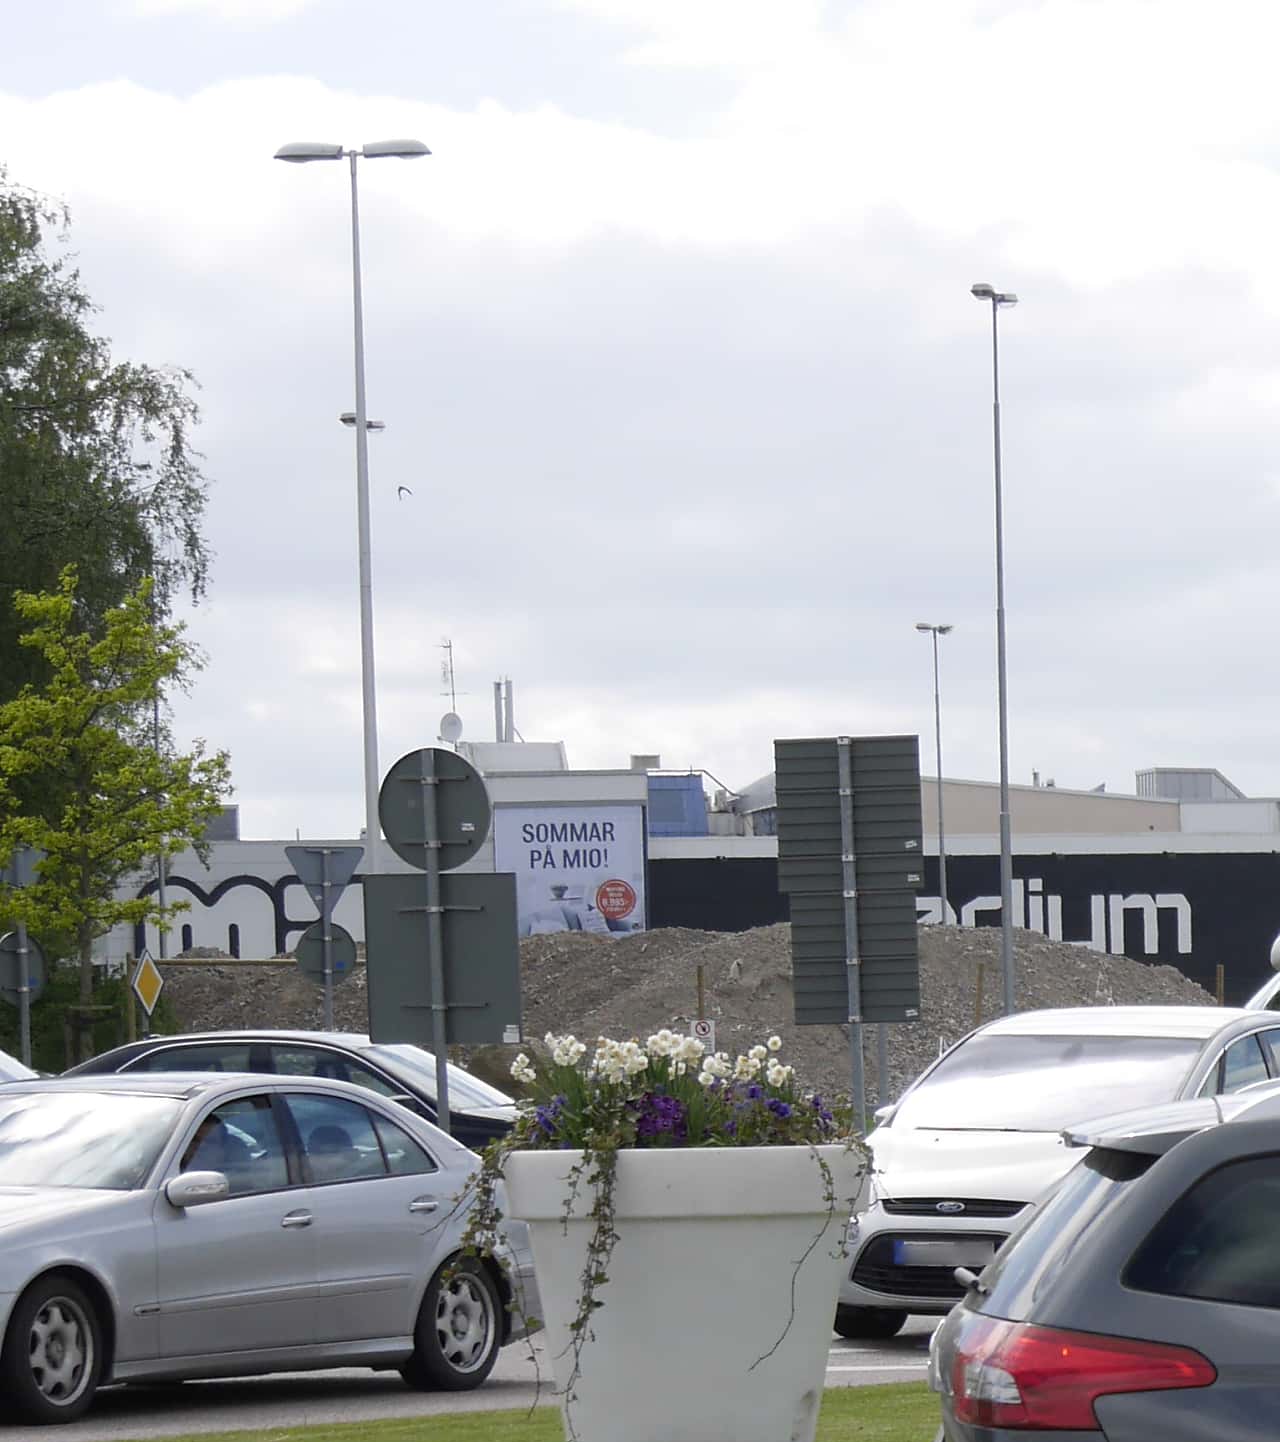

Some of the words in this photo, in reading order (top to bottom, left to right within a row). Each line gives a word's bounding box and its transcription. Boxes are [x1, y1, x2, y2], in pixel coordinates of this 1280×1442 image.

[522, 822, 615, 843] SOMMAR
[530, 844, 556, 869] PÅ
[563, 848, 609, 869] MIO!
